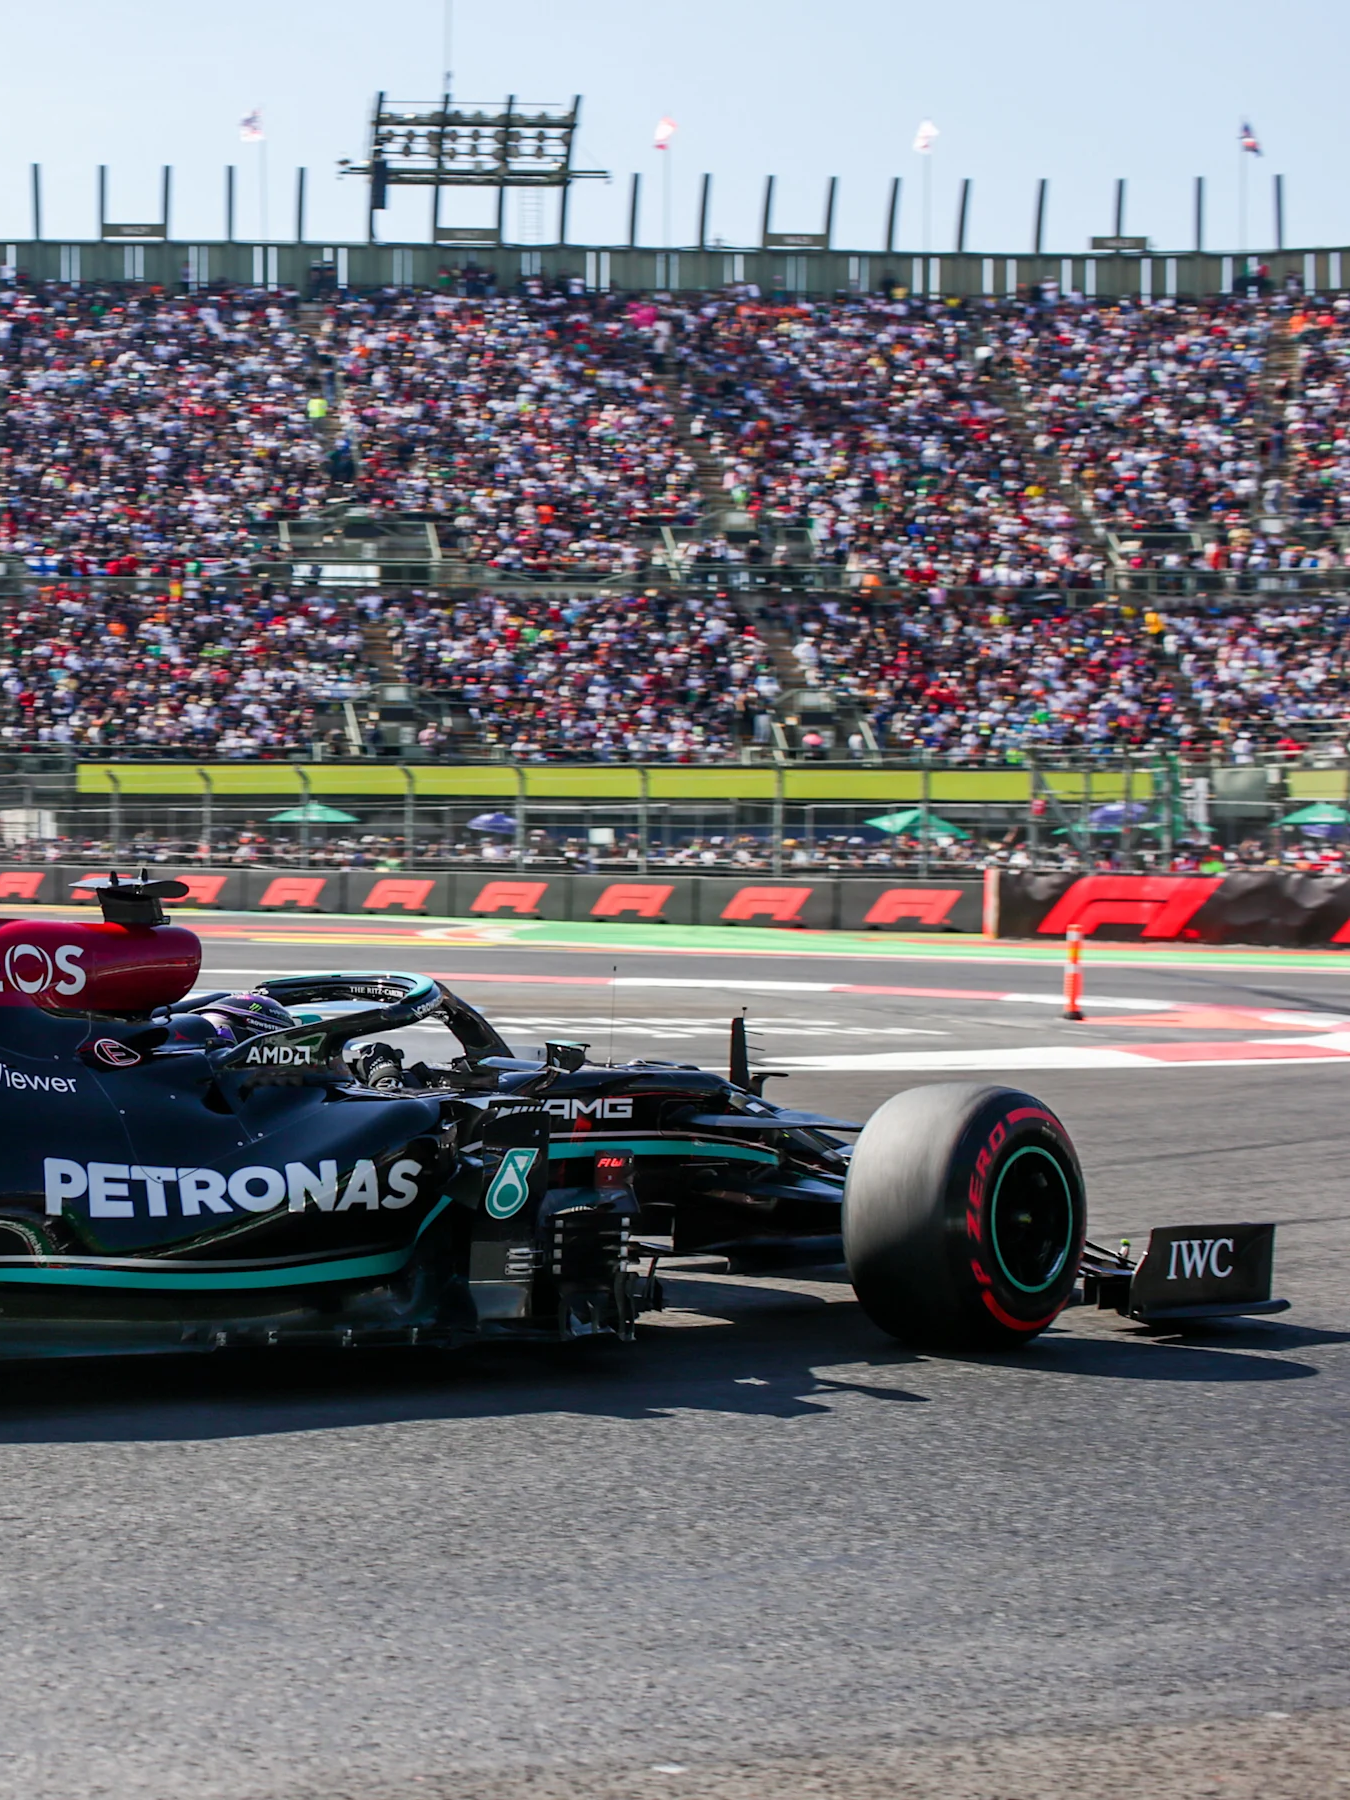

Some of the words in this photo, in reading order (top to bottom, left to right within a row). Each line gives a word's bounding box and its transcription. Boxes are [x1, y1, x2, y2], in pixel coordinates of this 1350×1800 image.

[246, 1045, 293, 1066] AMD
[546, 1097, 634, 1119] AMG
[43, 1156, 424, 1220] PETRONAS
[965, 1120, 1008, 1243] ZERO
[1165, 1237, 1234, 1281] IWC
